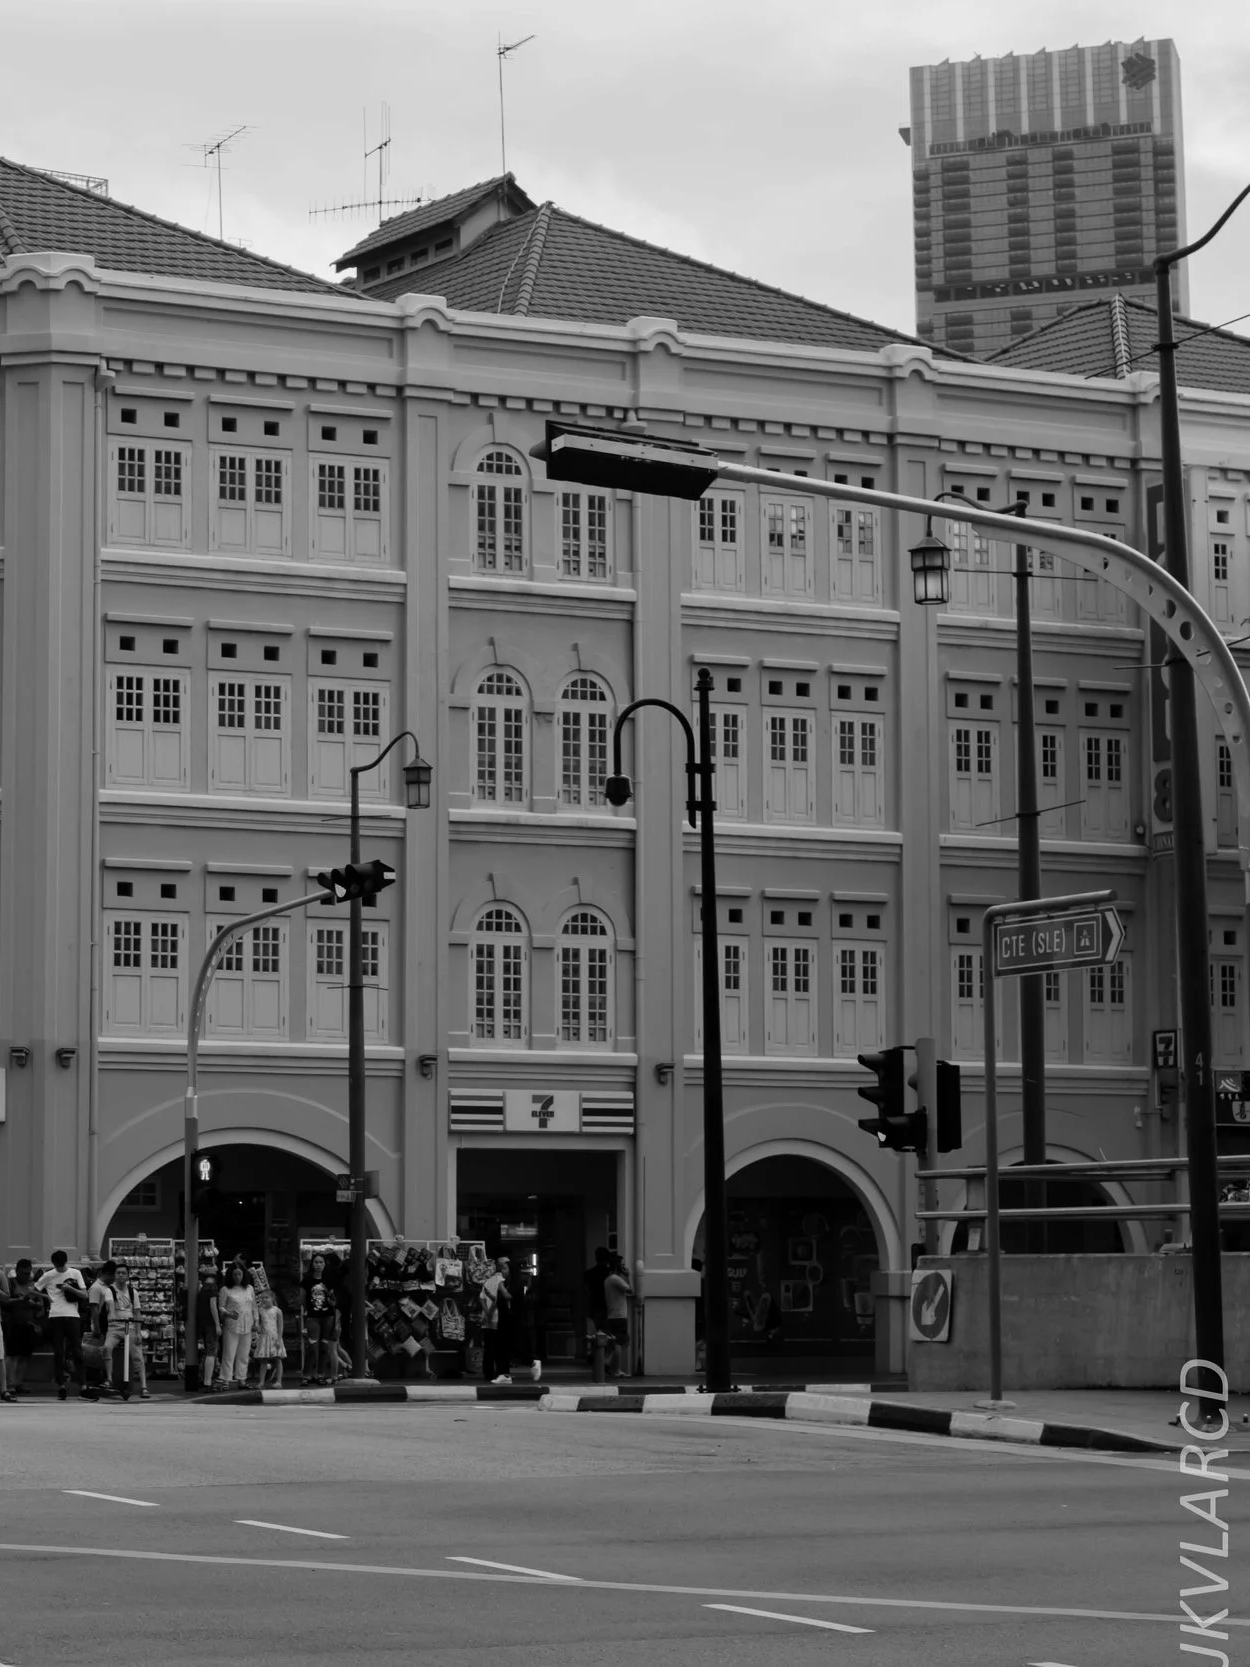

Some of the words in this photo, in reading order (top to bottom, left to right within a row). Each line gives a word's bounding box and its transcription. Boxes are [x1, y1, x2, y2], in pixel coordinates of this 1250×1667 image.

[1002, 934, 1026, 958] CTE
[1032, 927, 1066, 957] (SLE)
[531, 1094, 554, 1128] 7
